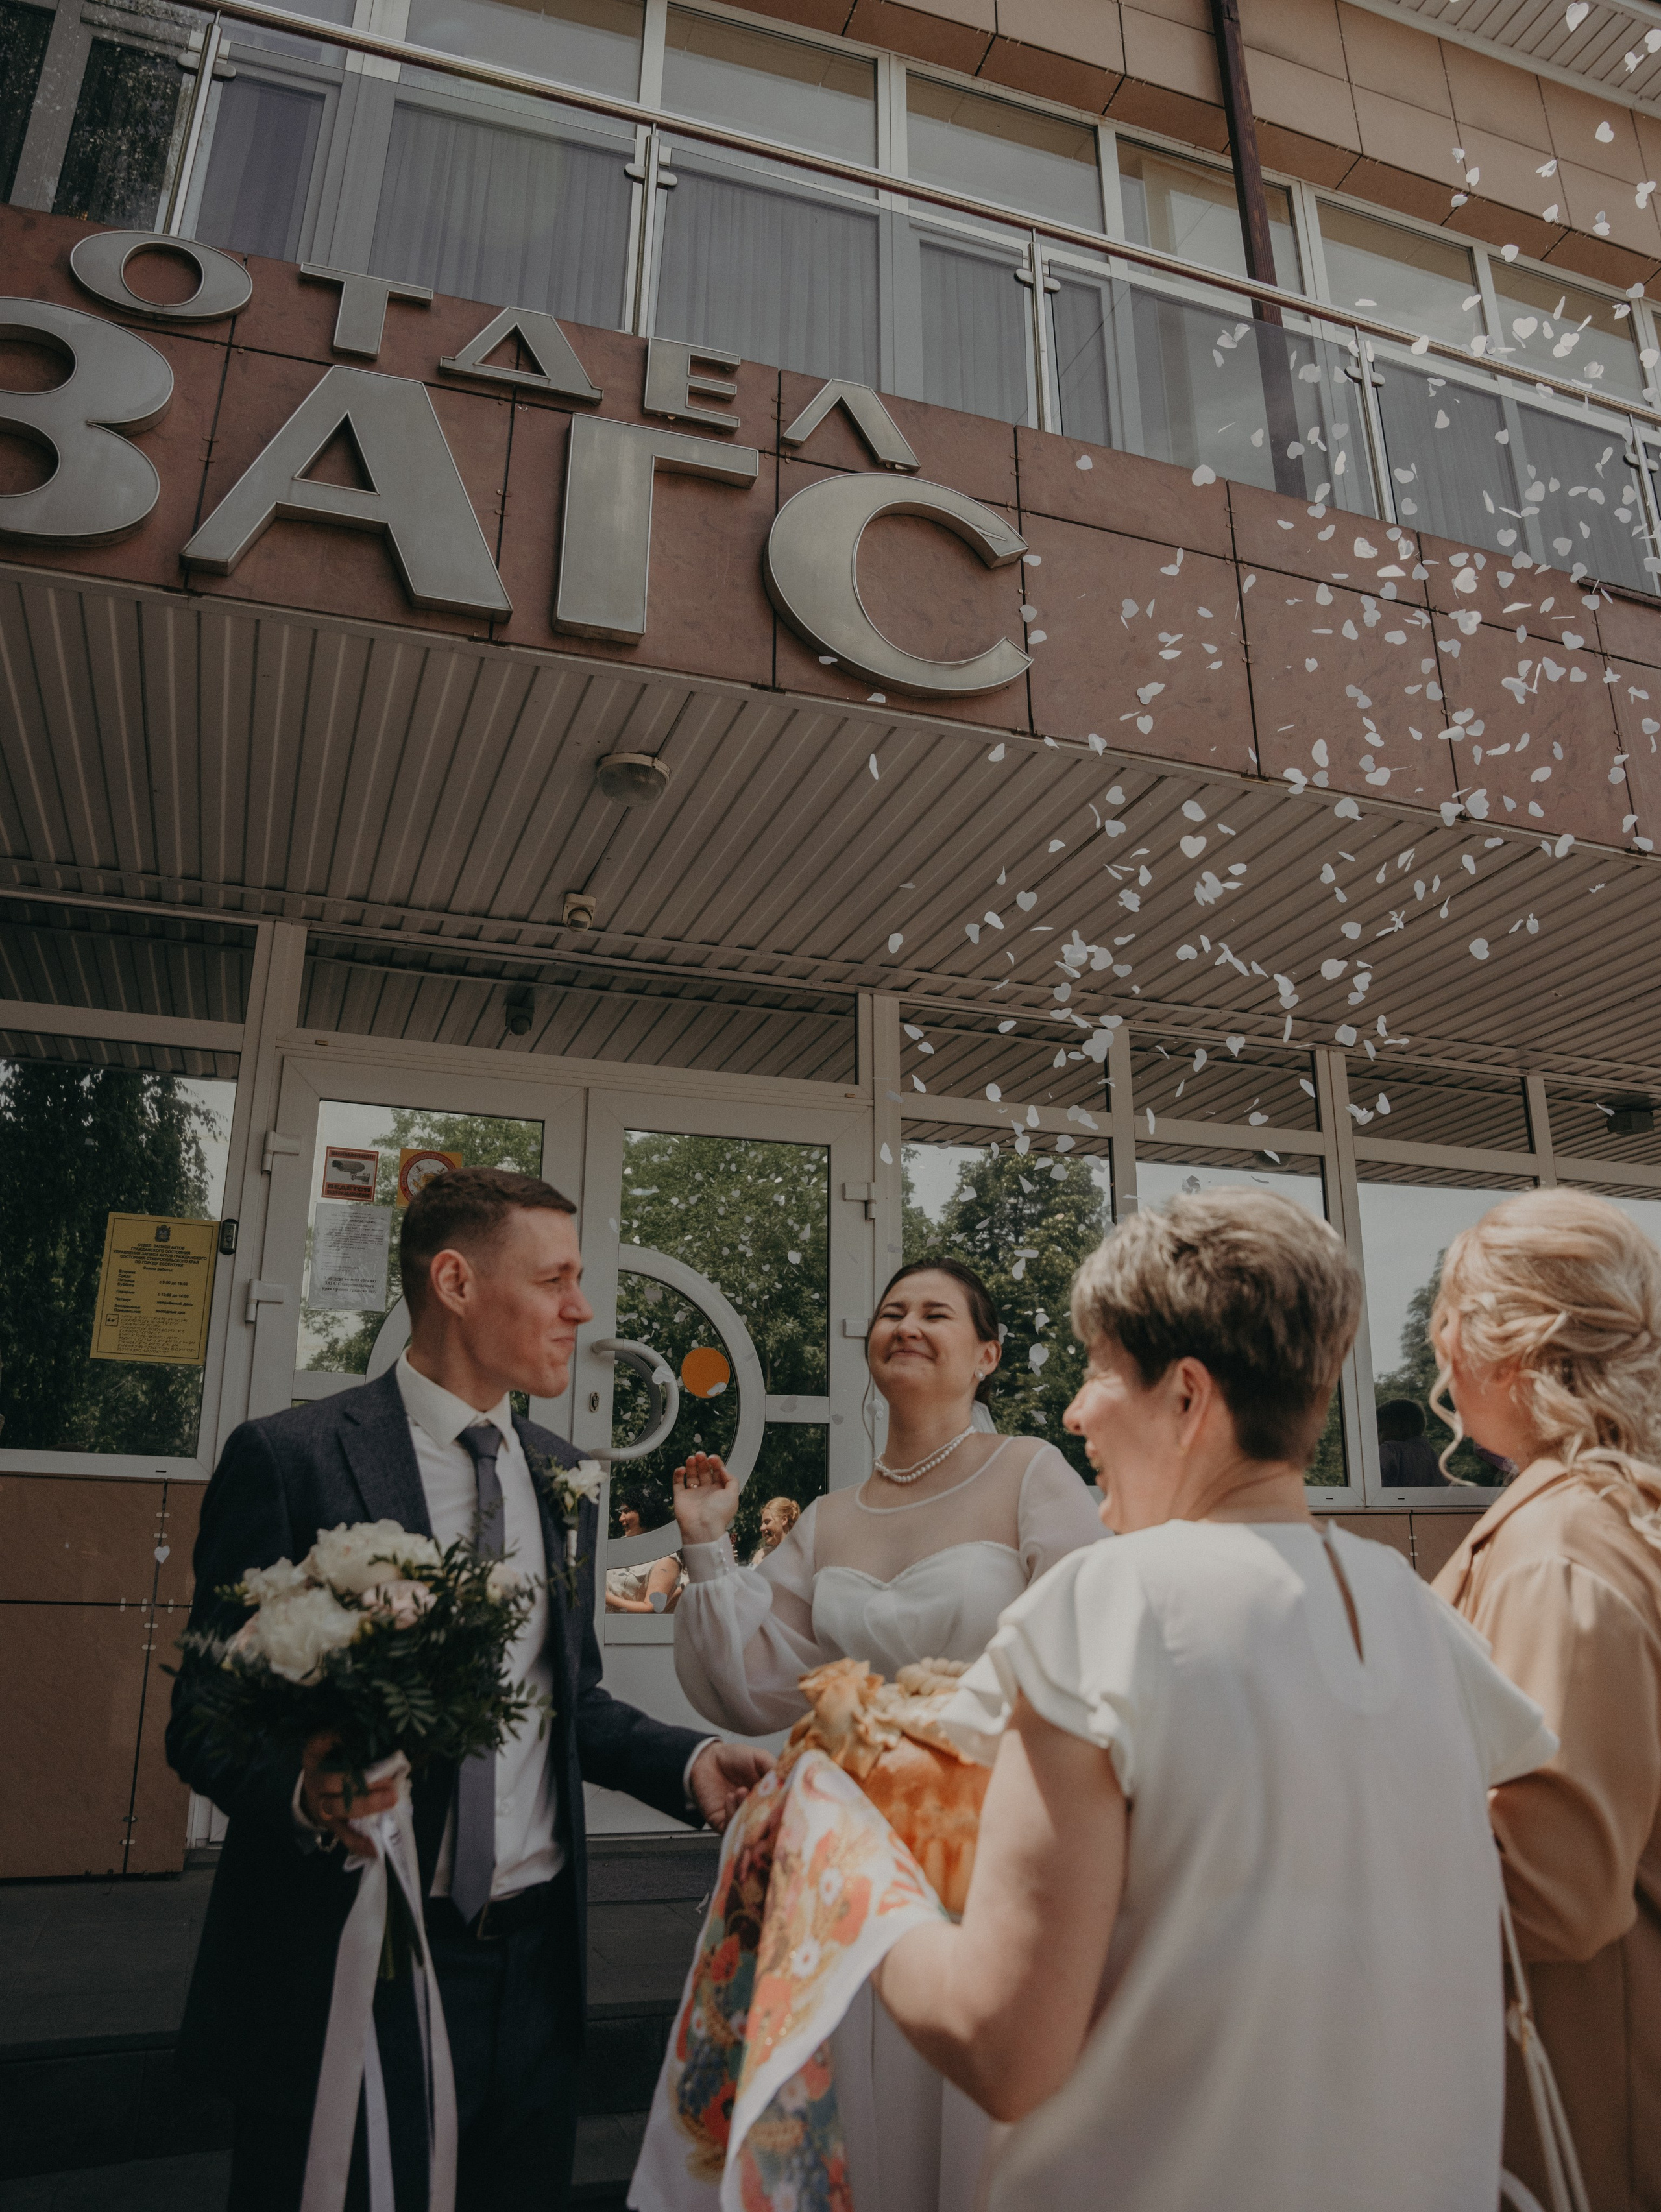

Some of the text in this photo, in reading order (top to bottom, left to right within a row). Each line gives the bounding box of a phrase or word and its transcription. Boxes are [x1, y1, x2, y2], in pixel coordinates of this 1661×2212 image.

[70, 230, 921, 472] ОТДЕЛ
[0, 296, 1034, 699] ЗАГС
[328, 1184, 370, 1192] ВЕДЕТСЯ
